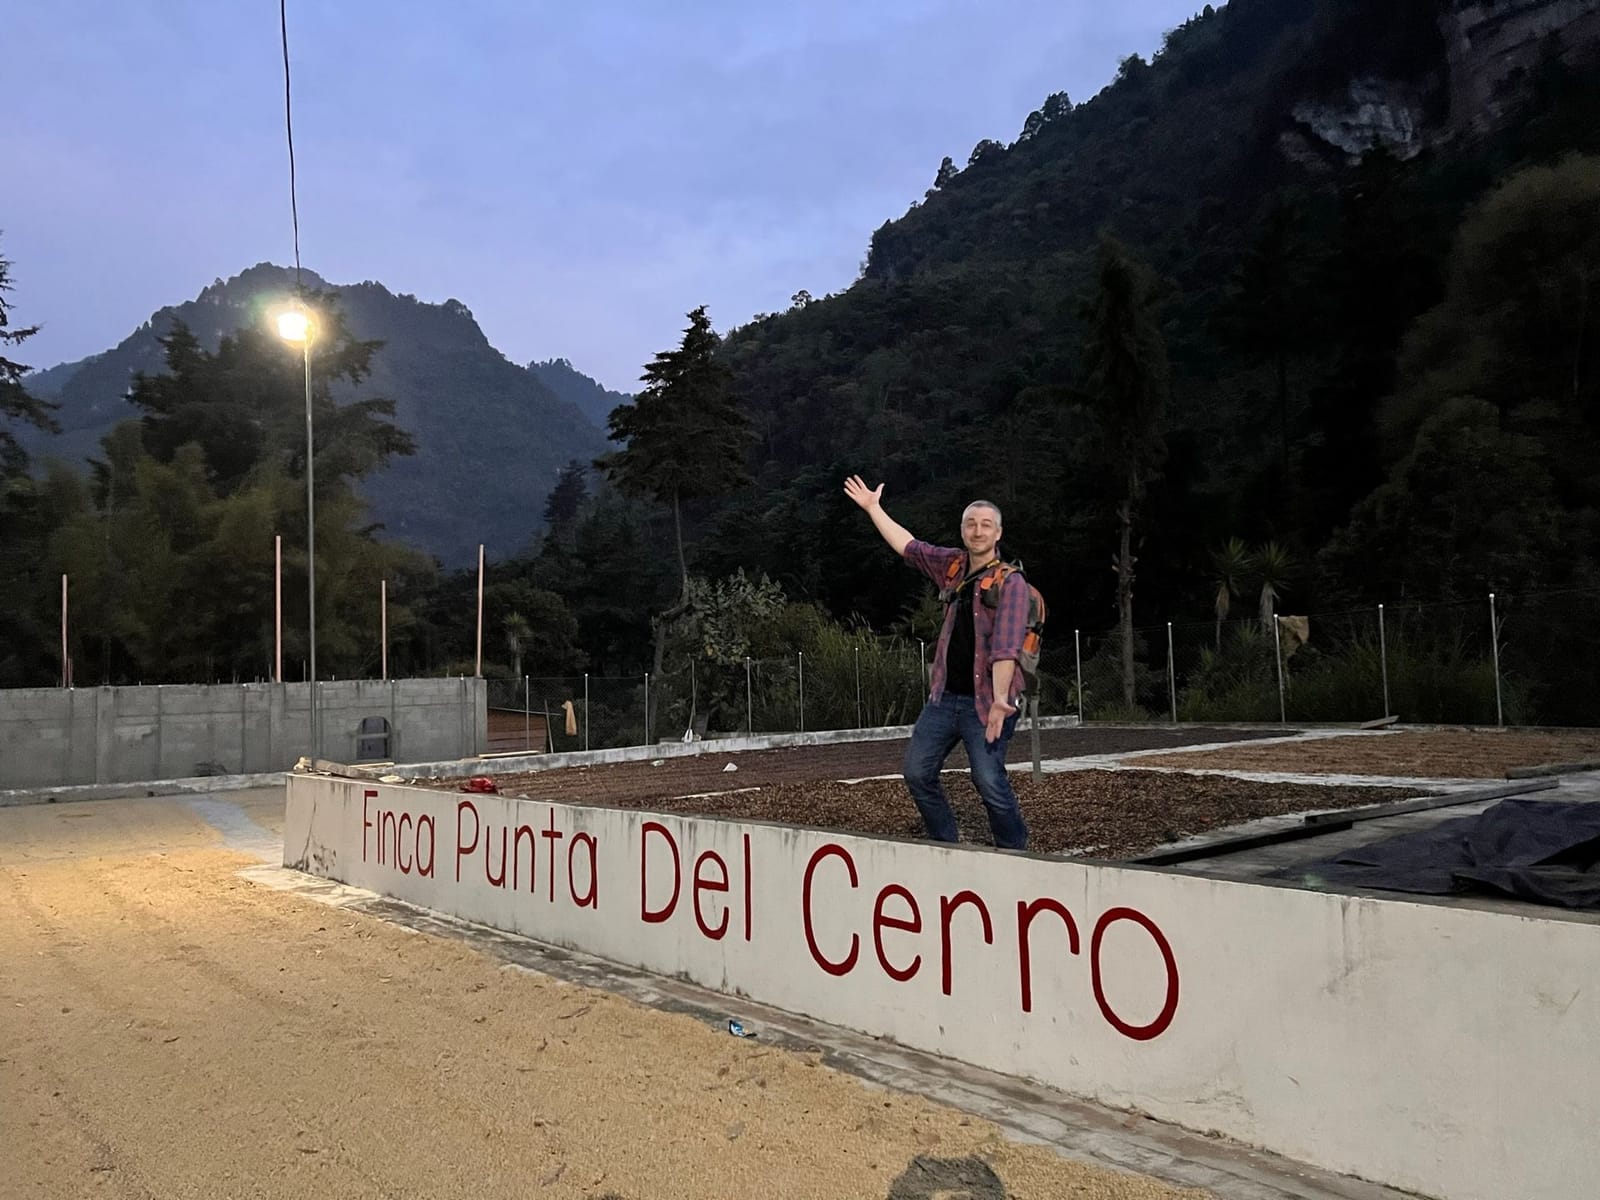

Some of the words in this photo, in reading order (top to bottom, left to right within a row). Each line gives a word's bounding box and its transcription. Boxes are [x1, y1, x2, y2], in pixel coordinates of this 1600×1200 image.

[363, 790, 435, 878] Finca
[456, 801, 598, 910] Punta
[641, 821, 753, 942] Del
[803, 843, 1179, 1041] Cerro
